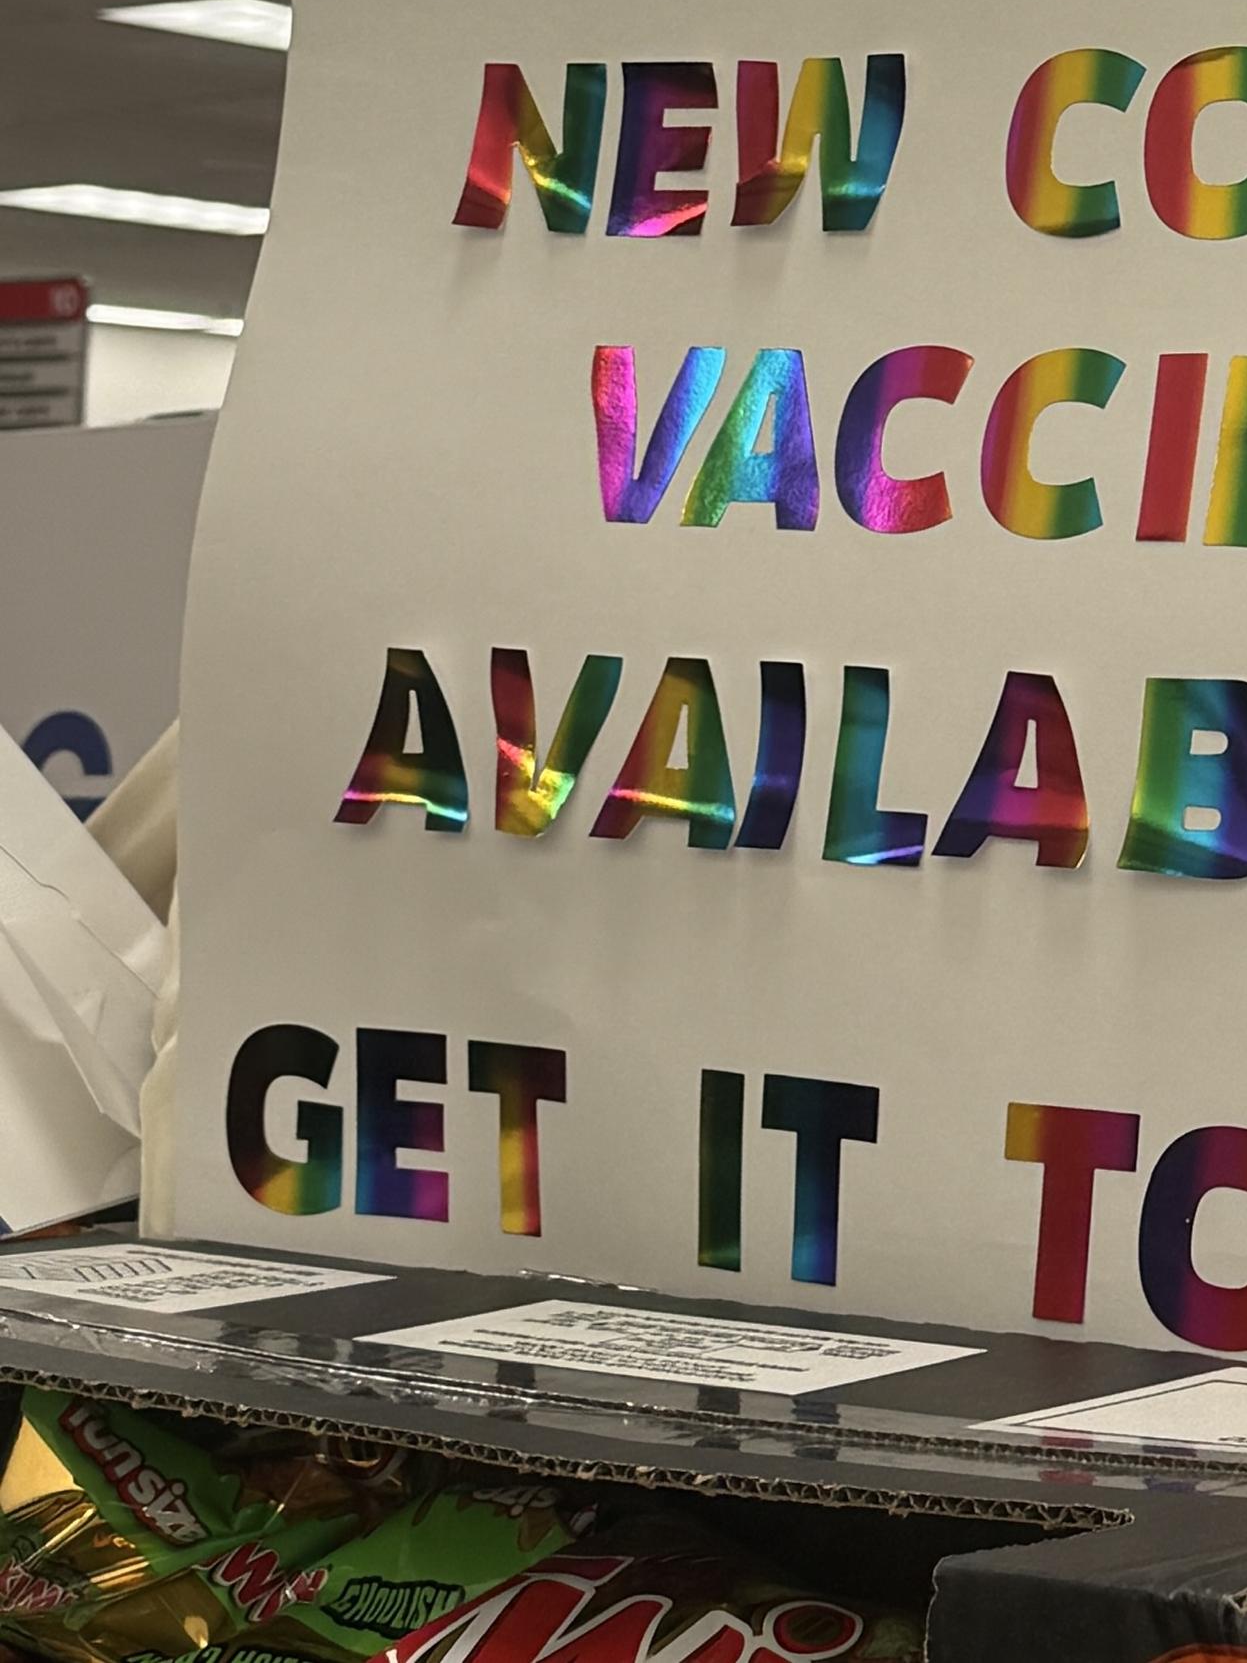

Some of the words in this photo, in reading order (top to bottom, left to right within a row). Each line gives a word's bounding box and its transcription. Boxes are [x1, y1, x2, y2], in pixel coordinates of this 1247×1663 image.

[451, 53, 907, 239] NEW
[225, 1022, 568, 1238] GET
[698, 1067, 881, 1286] IT
